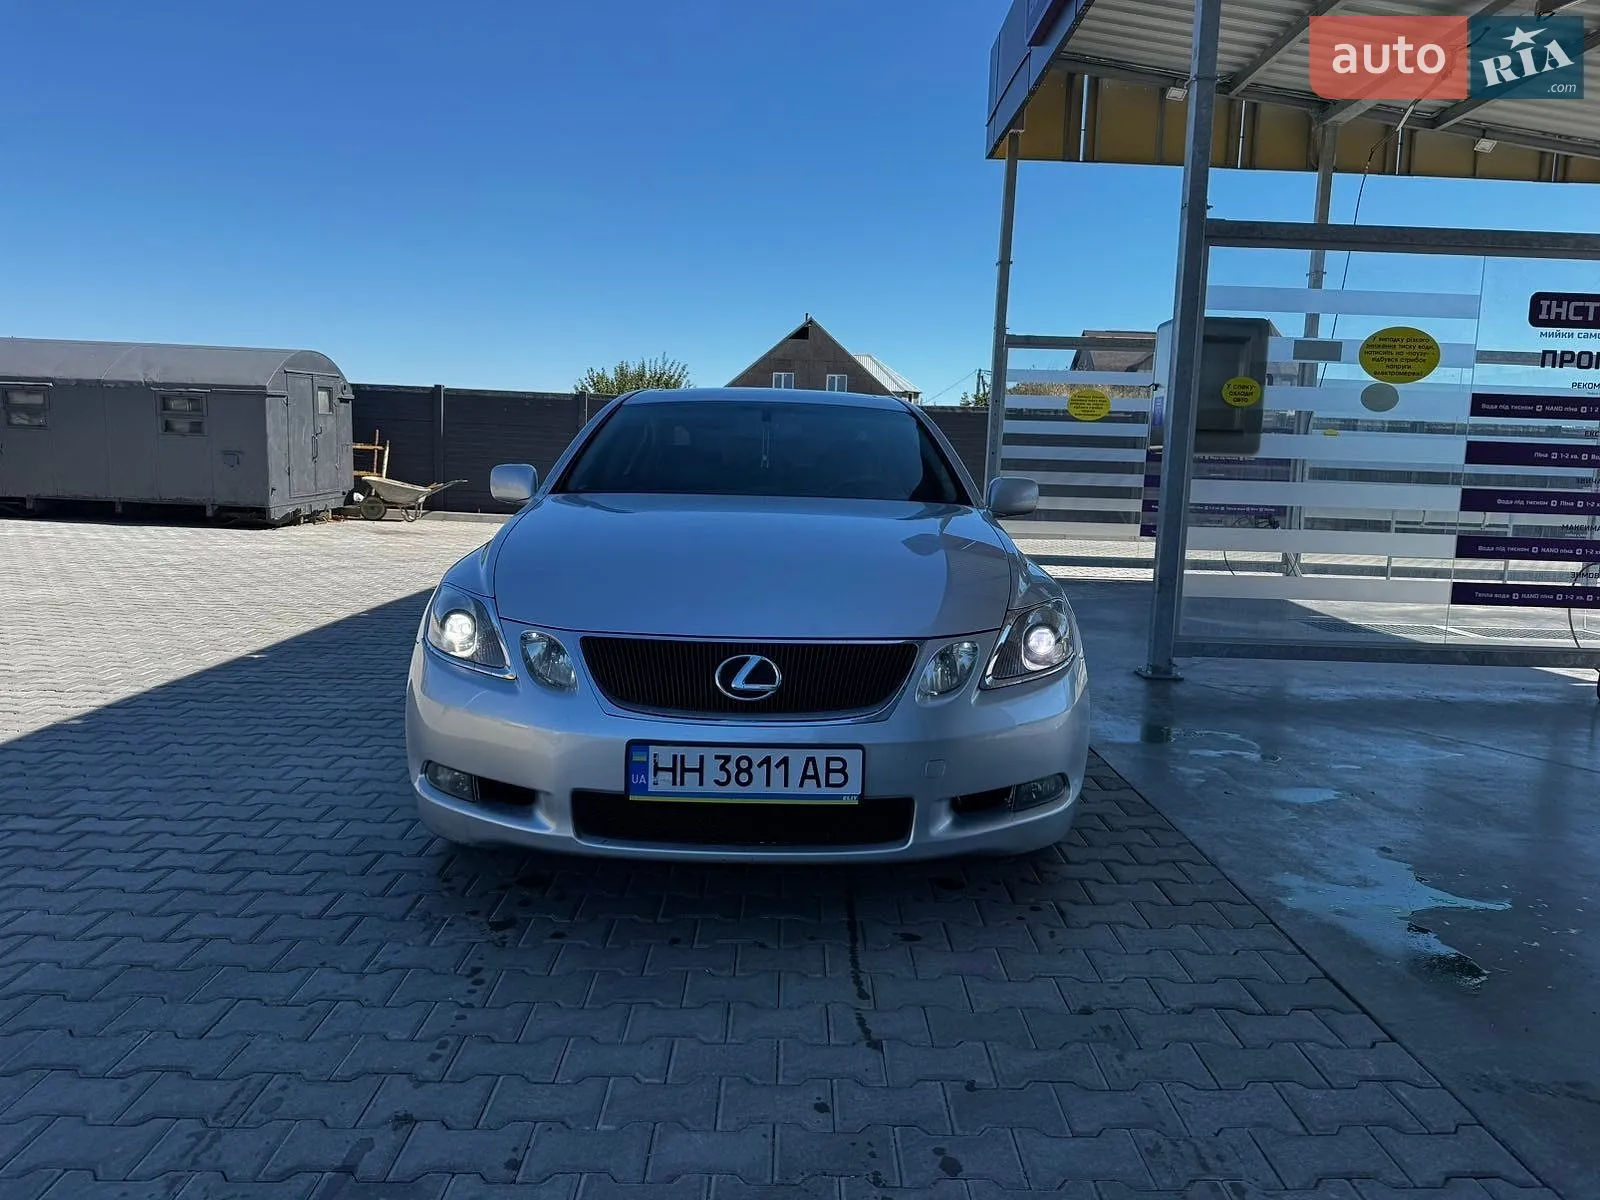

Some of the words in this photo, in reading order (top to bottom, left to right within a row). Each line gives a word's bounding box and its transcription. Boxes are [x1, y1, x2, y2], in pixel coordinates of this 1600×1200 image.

[1540, 329, 1574, 339] мийки
[631, 773, 647, 785] UA
[713, 754, 790, 788] 3811
[798, 756, 849, 788] AB
